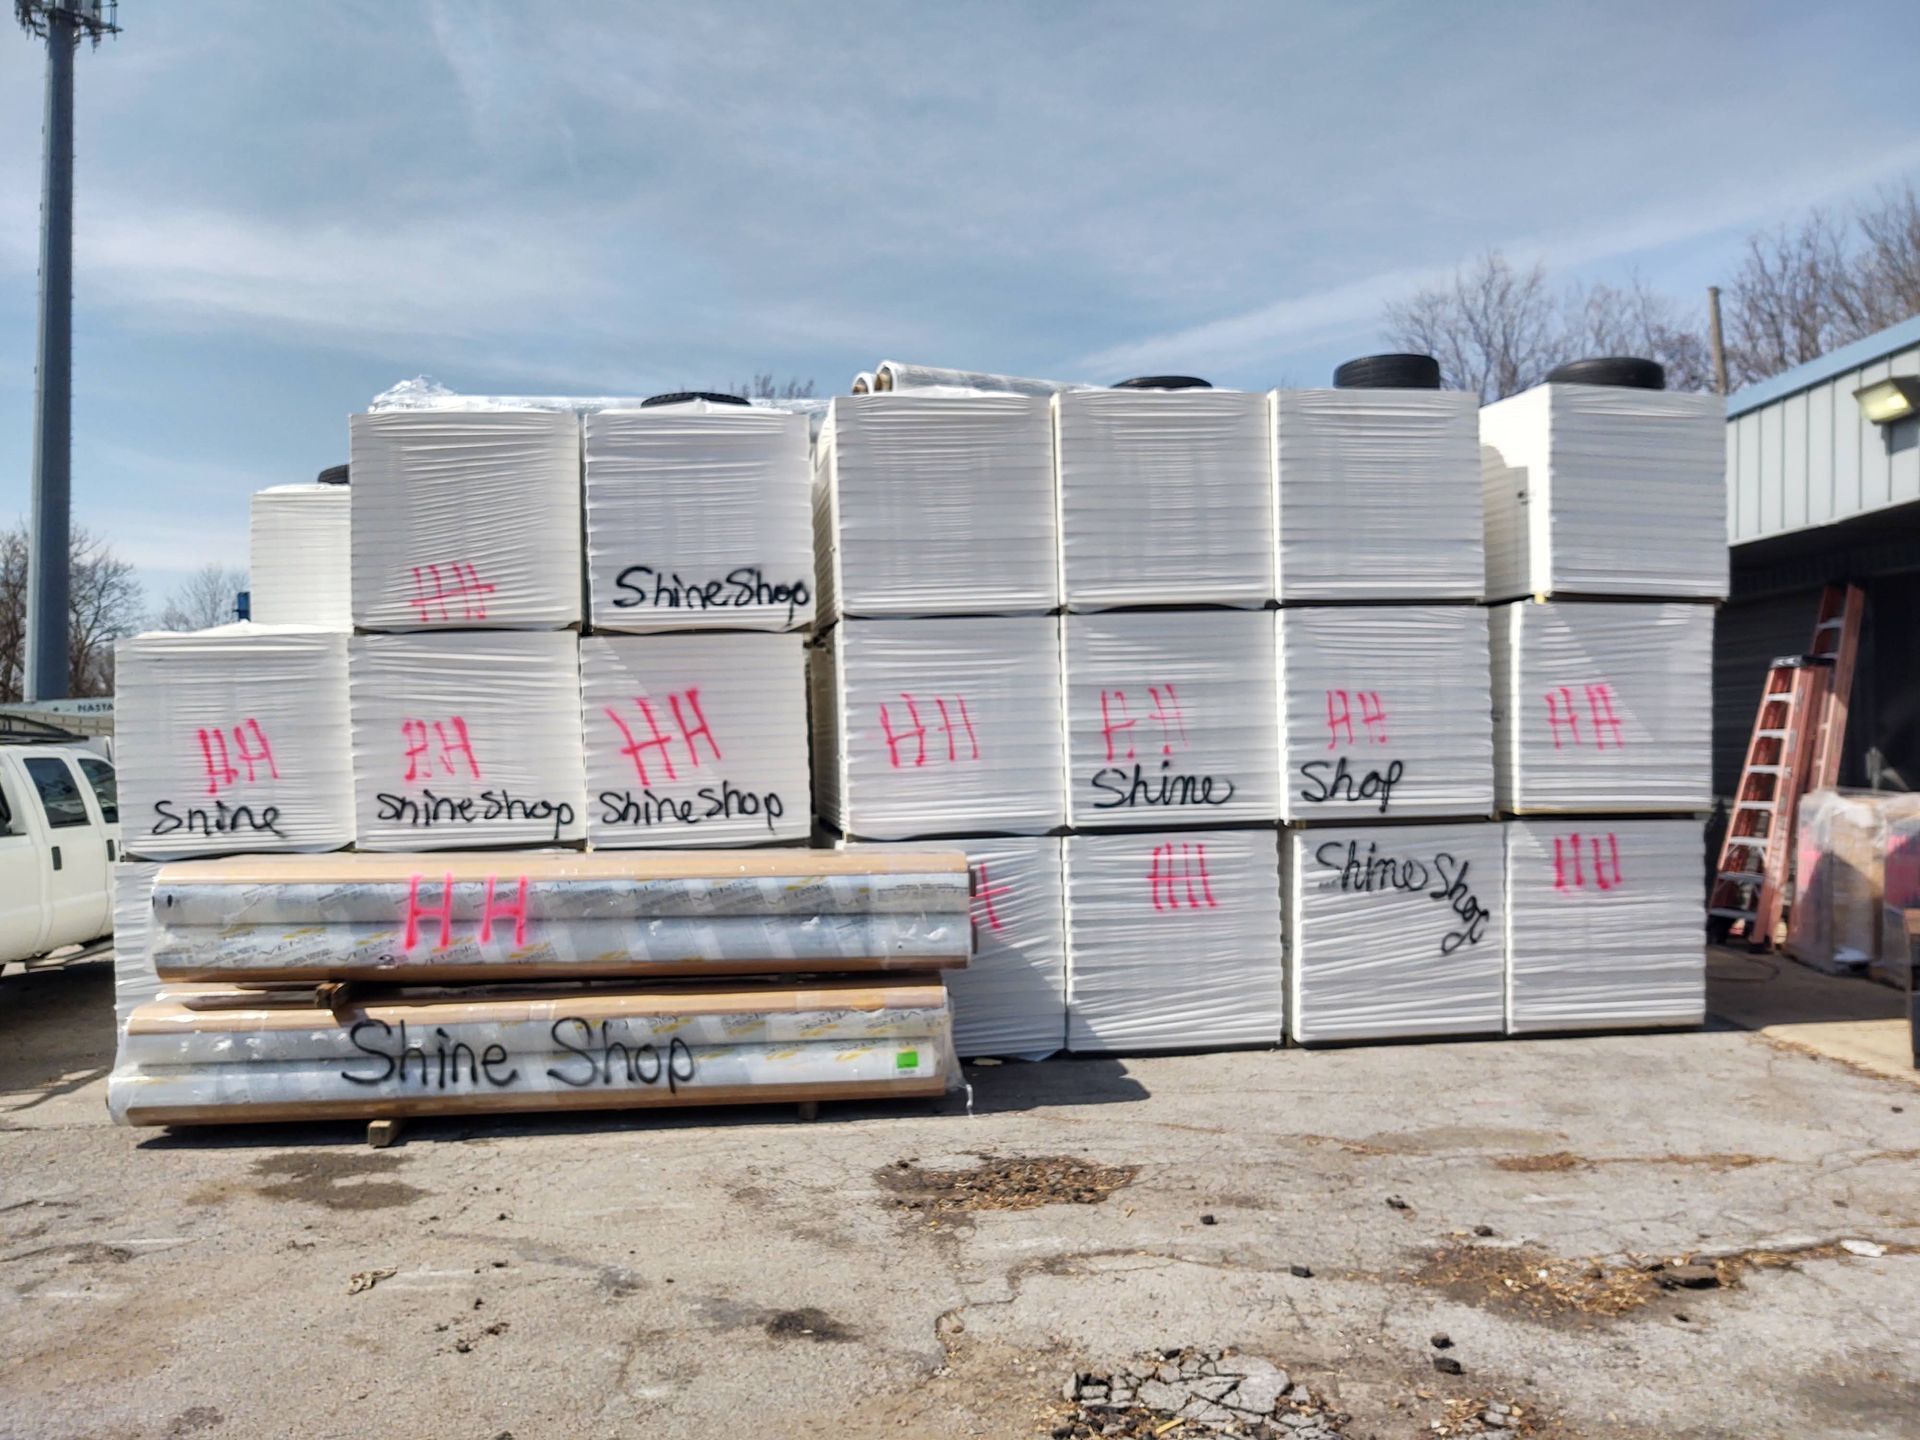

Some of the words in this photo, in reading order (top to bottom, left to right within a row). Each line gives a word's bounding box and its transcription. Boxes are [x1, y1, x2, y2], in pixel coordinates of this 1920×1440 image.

[1092, 760, 1235, 808] Shine
[1301, 757, 1404, 813] Shop
[340, 1018, 517, 1090] Shine
[547, 1016, 696, 1094] Shop
